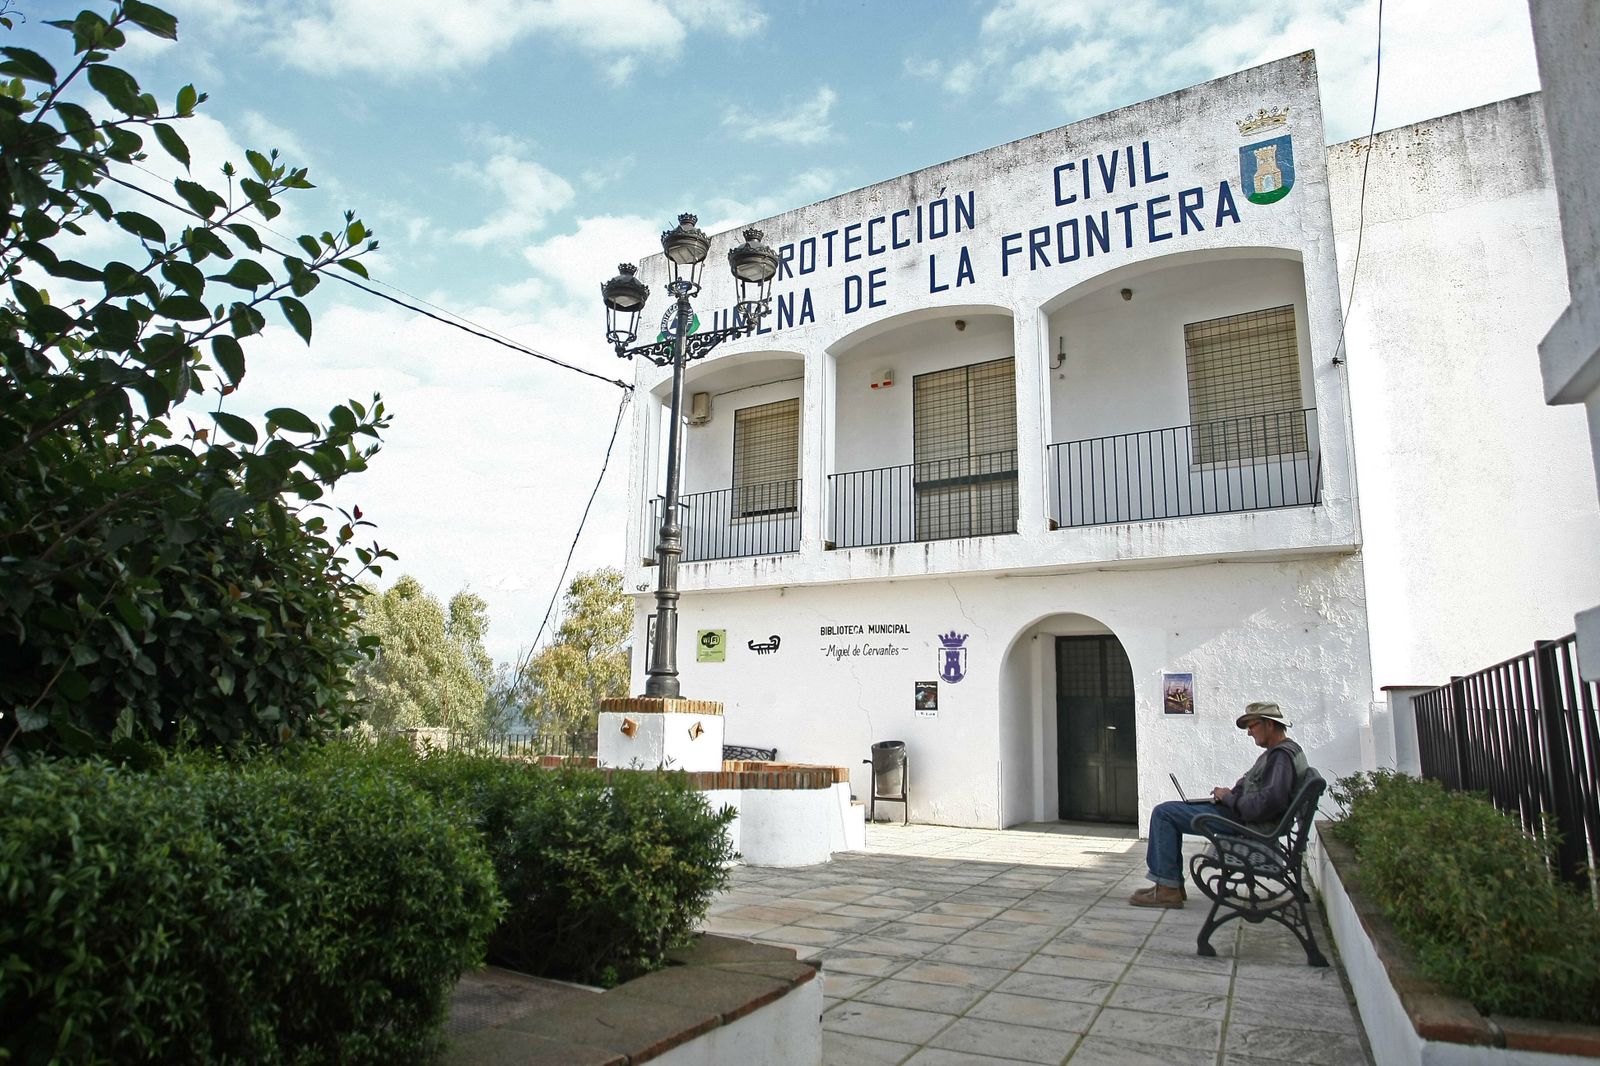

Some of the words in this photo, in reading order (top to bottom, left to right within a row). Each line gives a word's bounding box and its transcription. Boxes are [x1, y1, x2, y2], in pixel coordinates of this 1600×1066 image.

[757, 188, 975, 285] ROTECCIÓN
[1053, 140, 1169, 207] CIVIL
[844, 267, 887, 315] DE
[929, 246, 976, 294] LA
[1002, 180, 1241, 276] FRONTERA
[820, 624, 864, 636] BIBLIOTECA
[868, 623, 911, 634] MUNICIPAL
[852, 644, 861, 657] de
